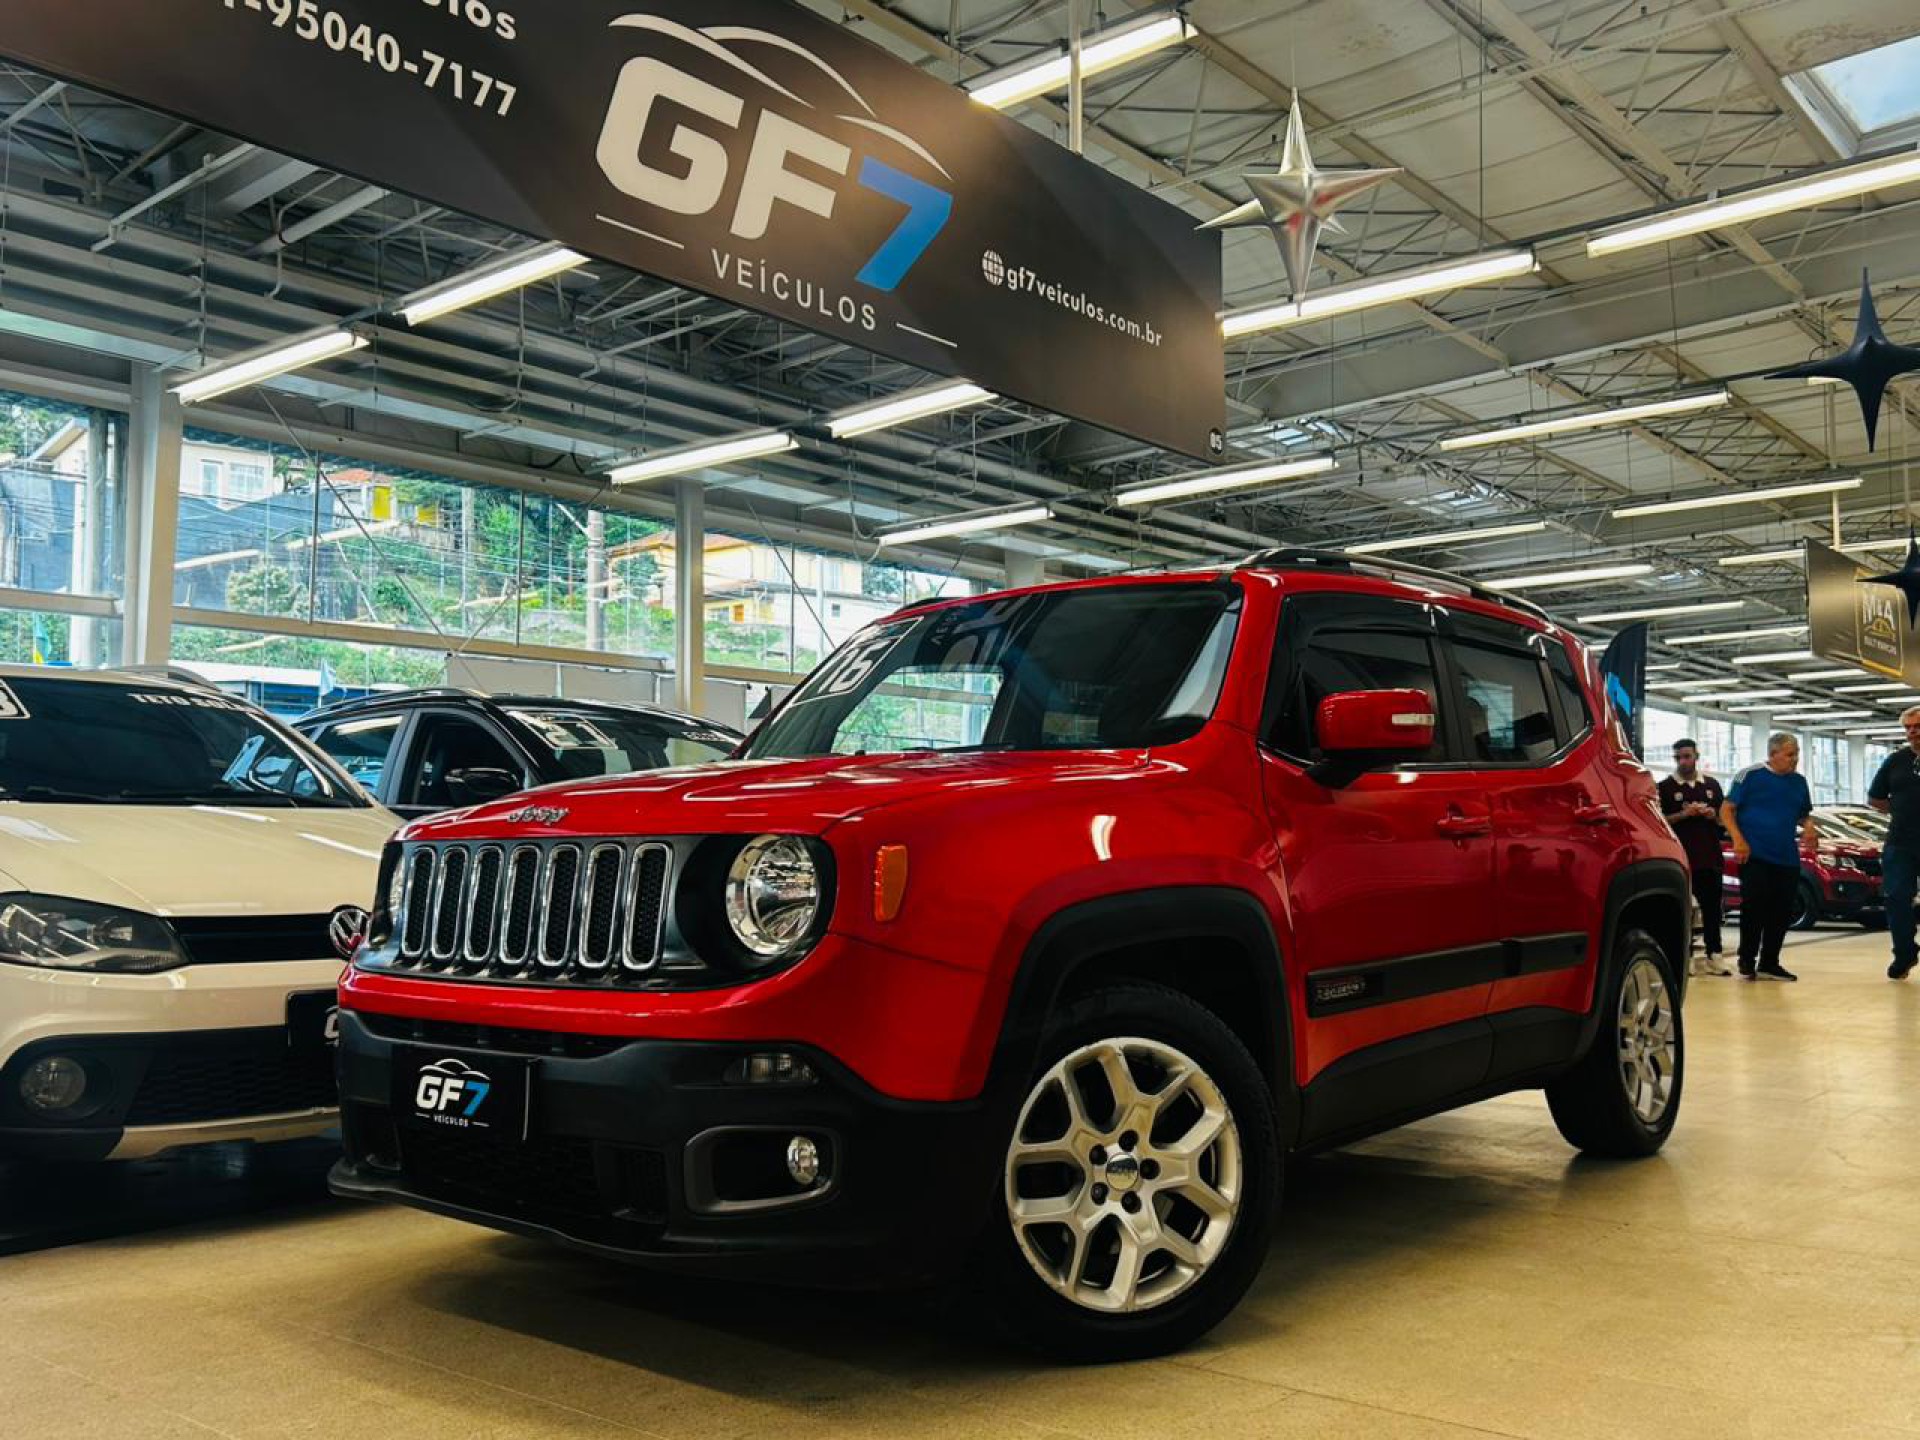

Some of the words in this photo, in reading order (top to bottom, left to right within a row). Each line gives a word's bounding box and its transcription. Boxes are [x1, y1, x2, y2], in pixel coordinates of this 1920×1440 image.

[596, 55, 953, 293] GF7
[711, 248, 877, 331] VEÍCULOS
[1006, 266, 1162, 346] gf7veiculos.com.br
[507, 803, 570, 826] Jeep
[416, 1075, 490, 1117] GF7
